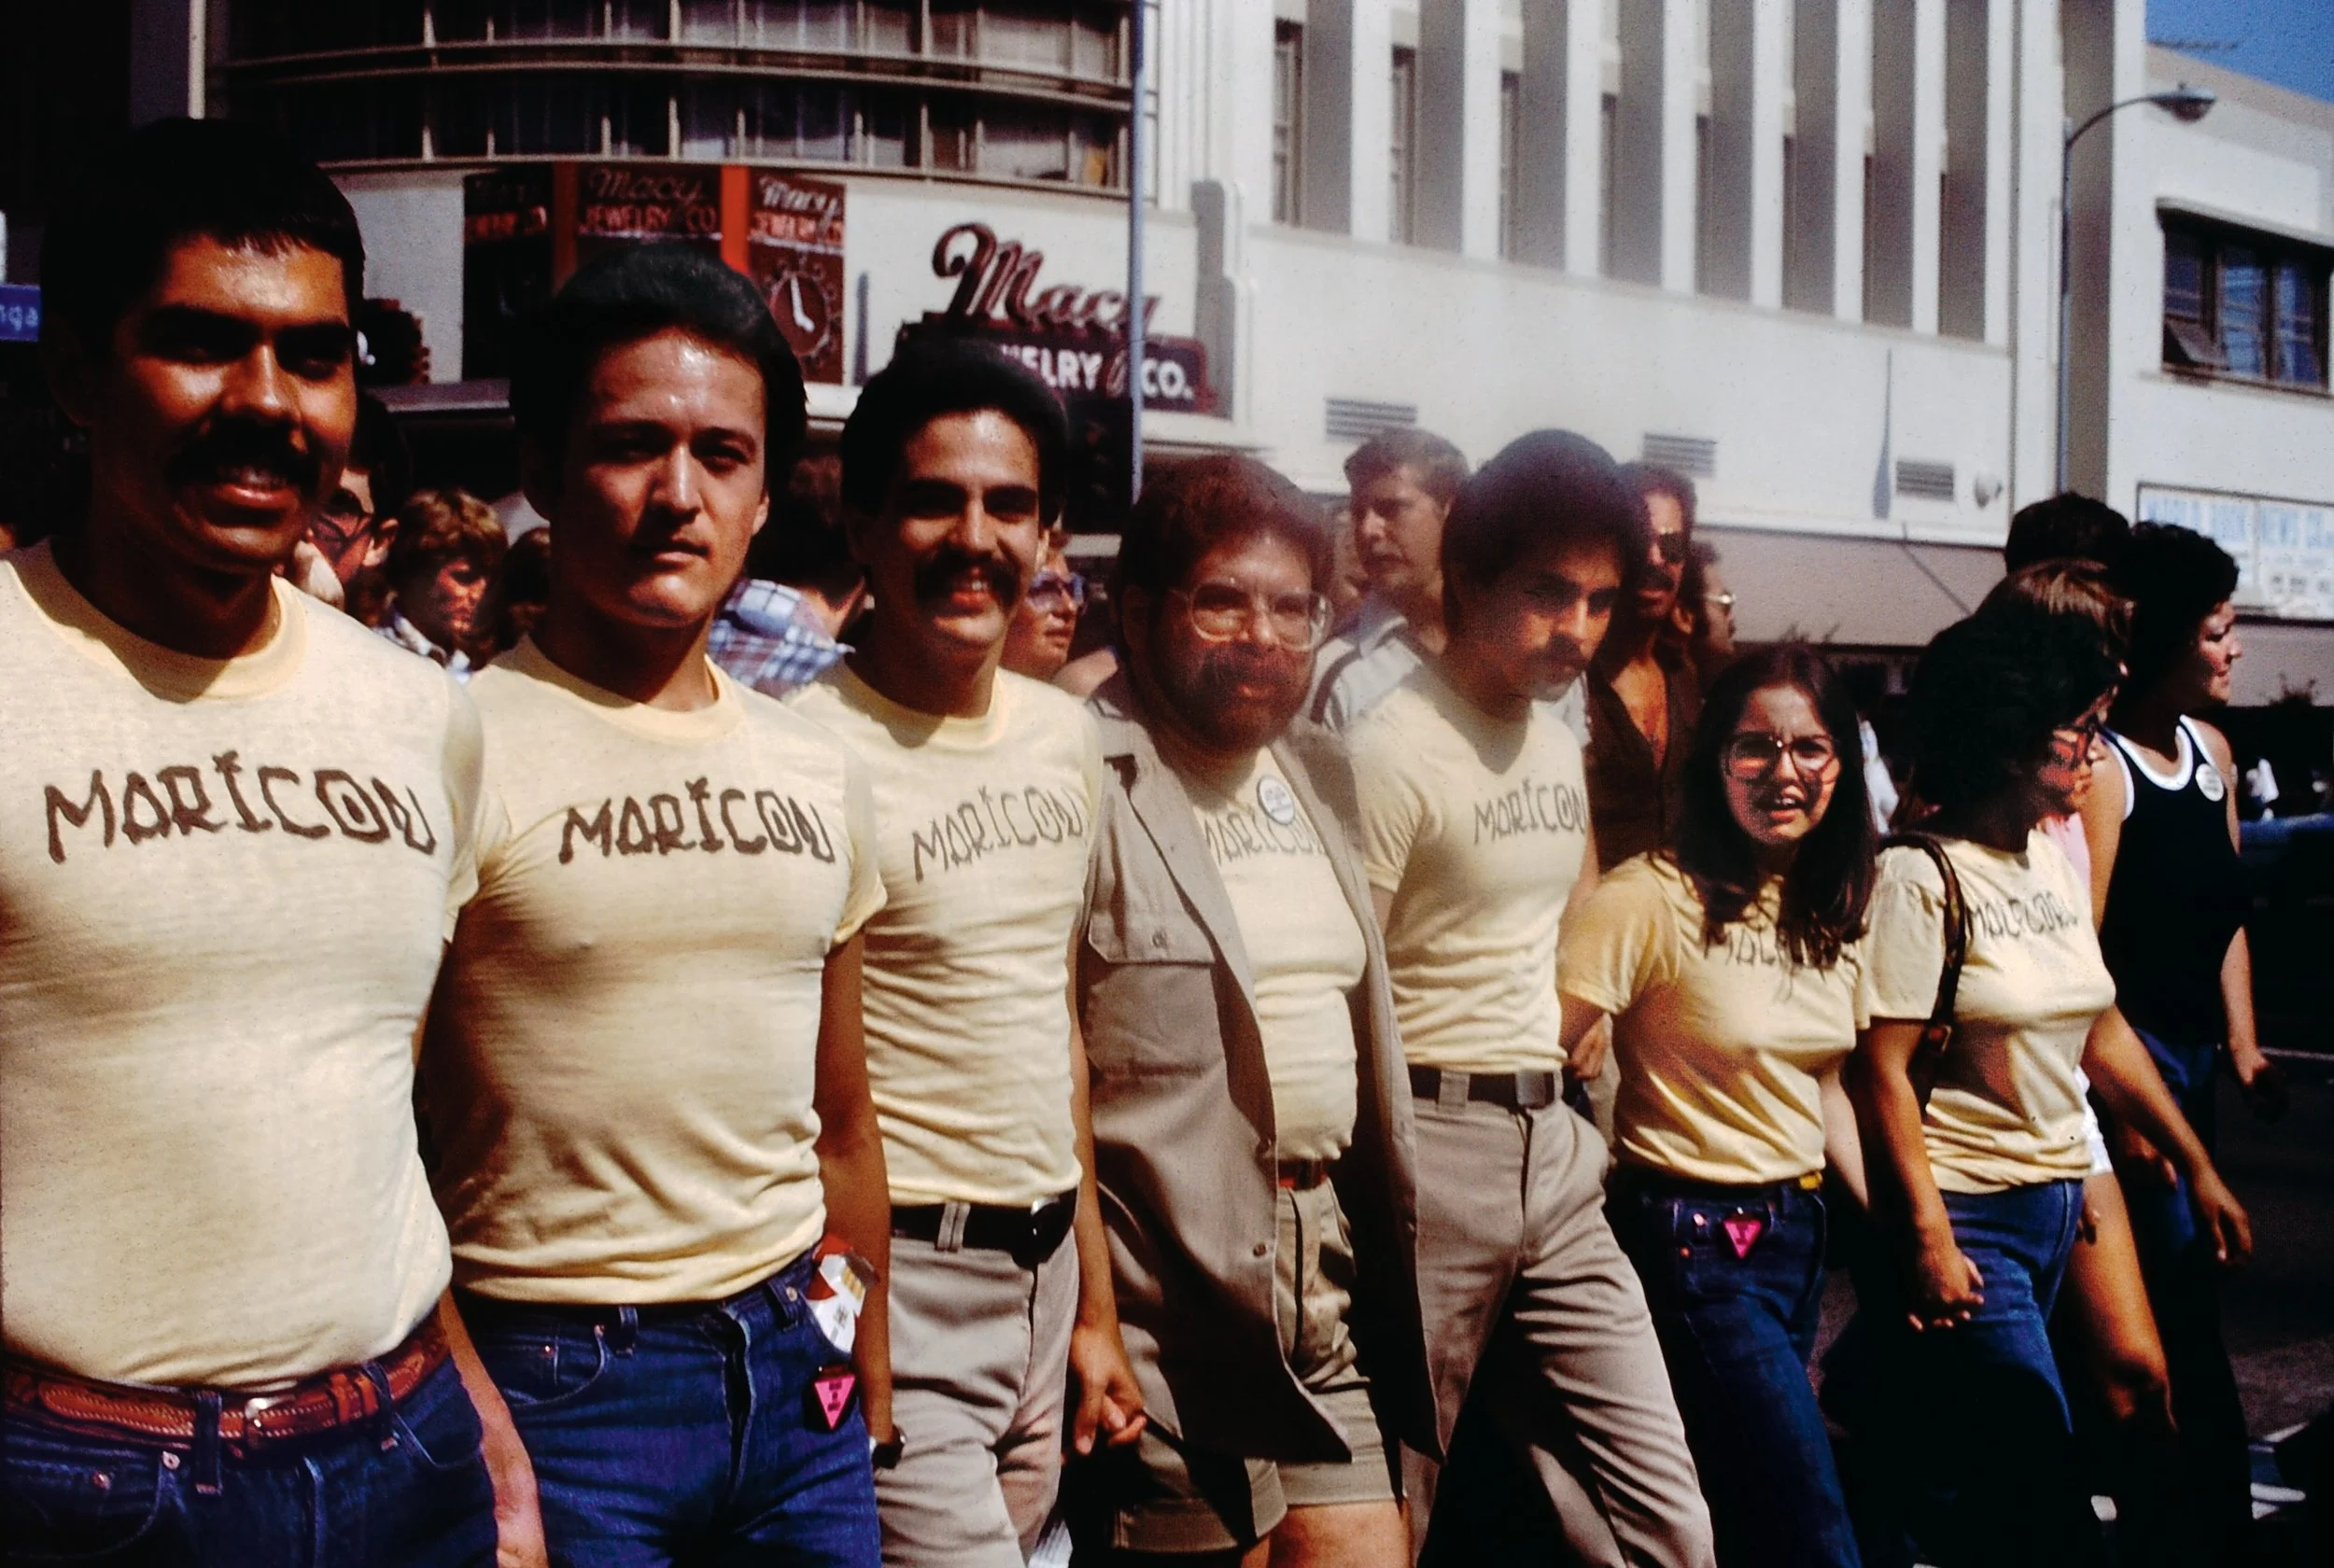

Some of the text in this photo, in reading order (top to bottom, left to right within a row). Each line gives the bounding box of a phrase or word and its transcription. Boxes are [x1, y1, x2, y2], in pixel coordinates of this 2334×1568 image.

[931, 221, 1161, 396] Macy
[44, 749, 437, 863] MARICON
[558, 776, 837, 864] MARICON
[911, 783, 1084, 885] MARICON
